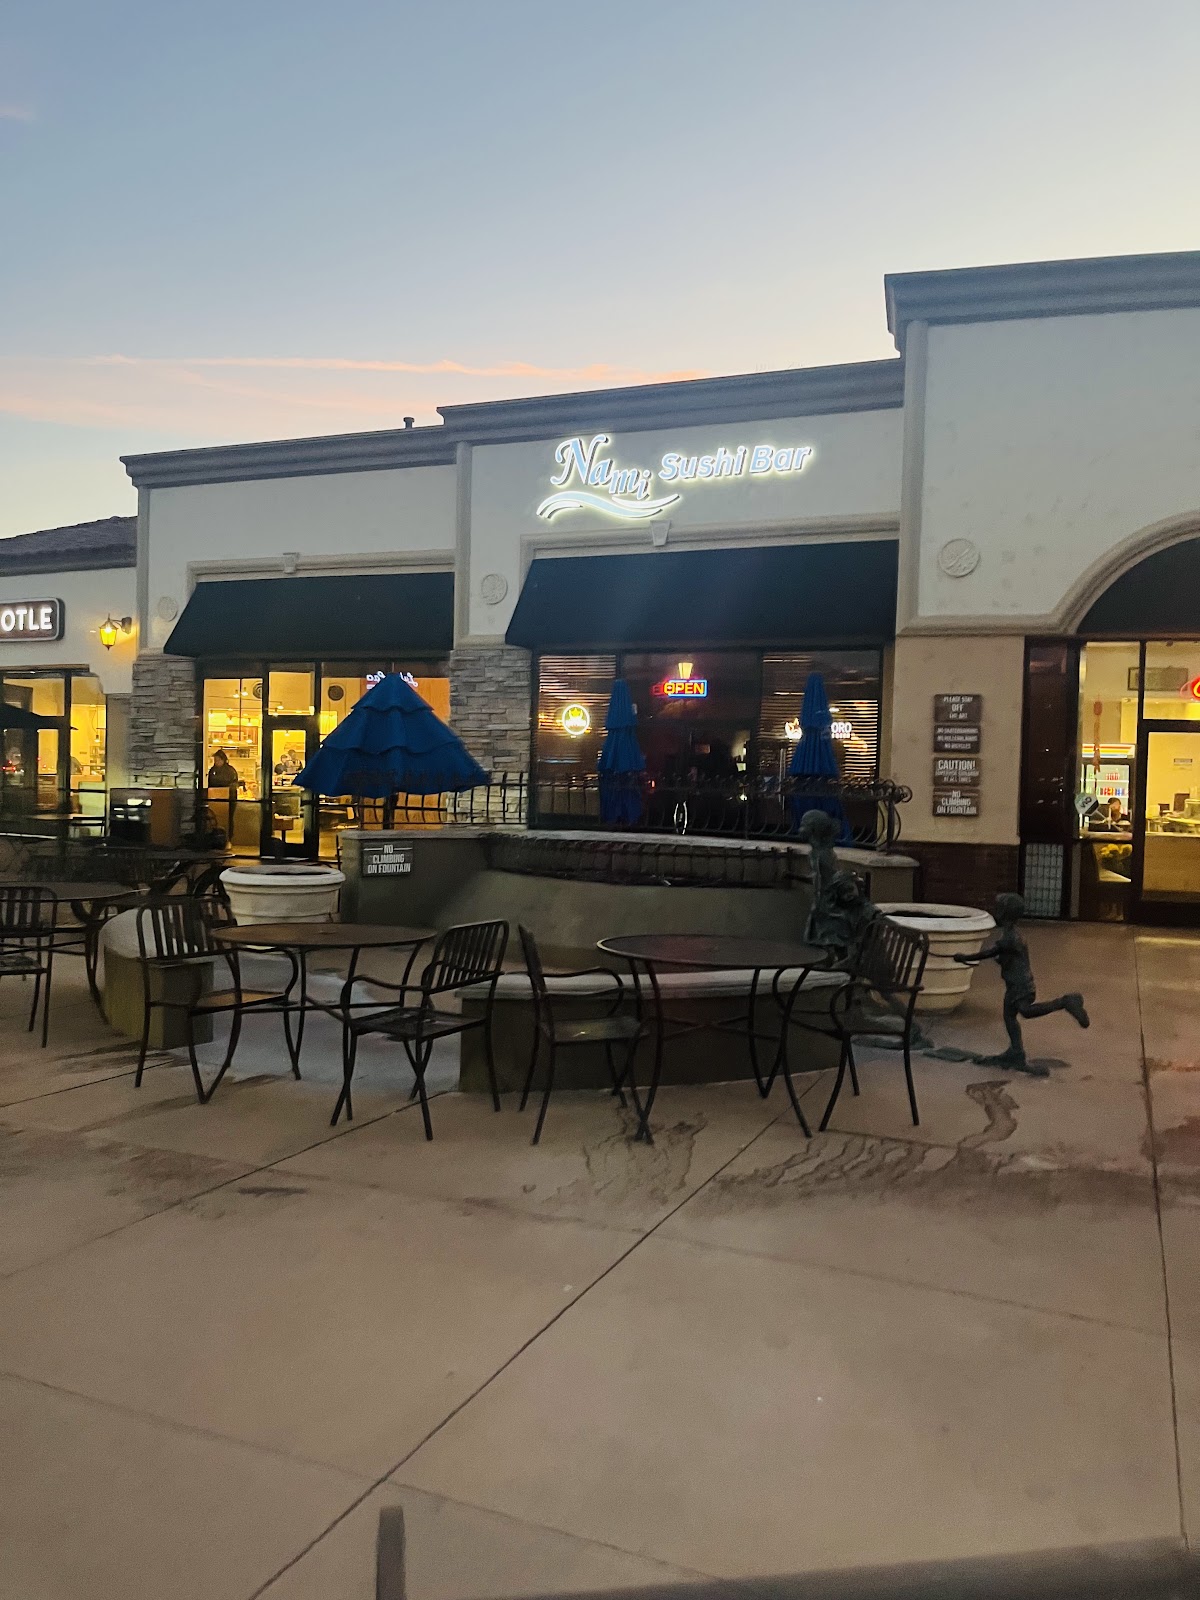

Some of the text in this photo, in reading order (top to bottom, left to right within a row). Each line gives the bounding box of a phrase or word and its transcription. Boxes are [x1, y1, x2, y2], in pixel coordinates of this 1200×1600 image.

[550, 434, 812, 500] Nami Sushi Bar
[0, 606, 53, 632] OTLE
[663, 682, 705, 695] OPEN
[951, 703, 964, 711] OFF
[938, 759, 976, 770] CAUTION!
[952, 790, 961, 798] NO
[941, 797, 972, 806] CLIMBING
[936, 804, 977, 815] ON FOUNTAIN
[383, 844, 394, 854] NO
[372, 853, 405, 864] CLIMBING
[367, 863, 411, 874] ON FOUNTAIN
